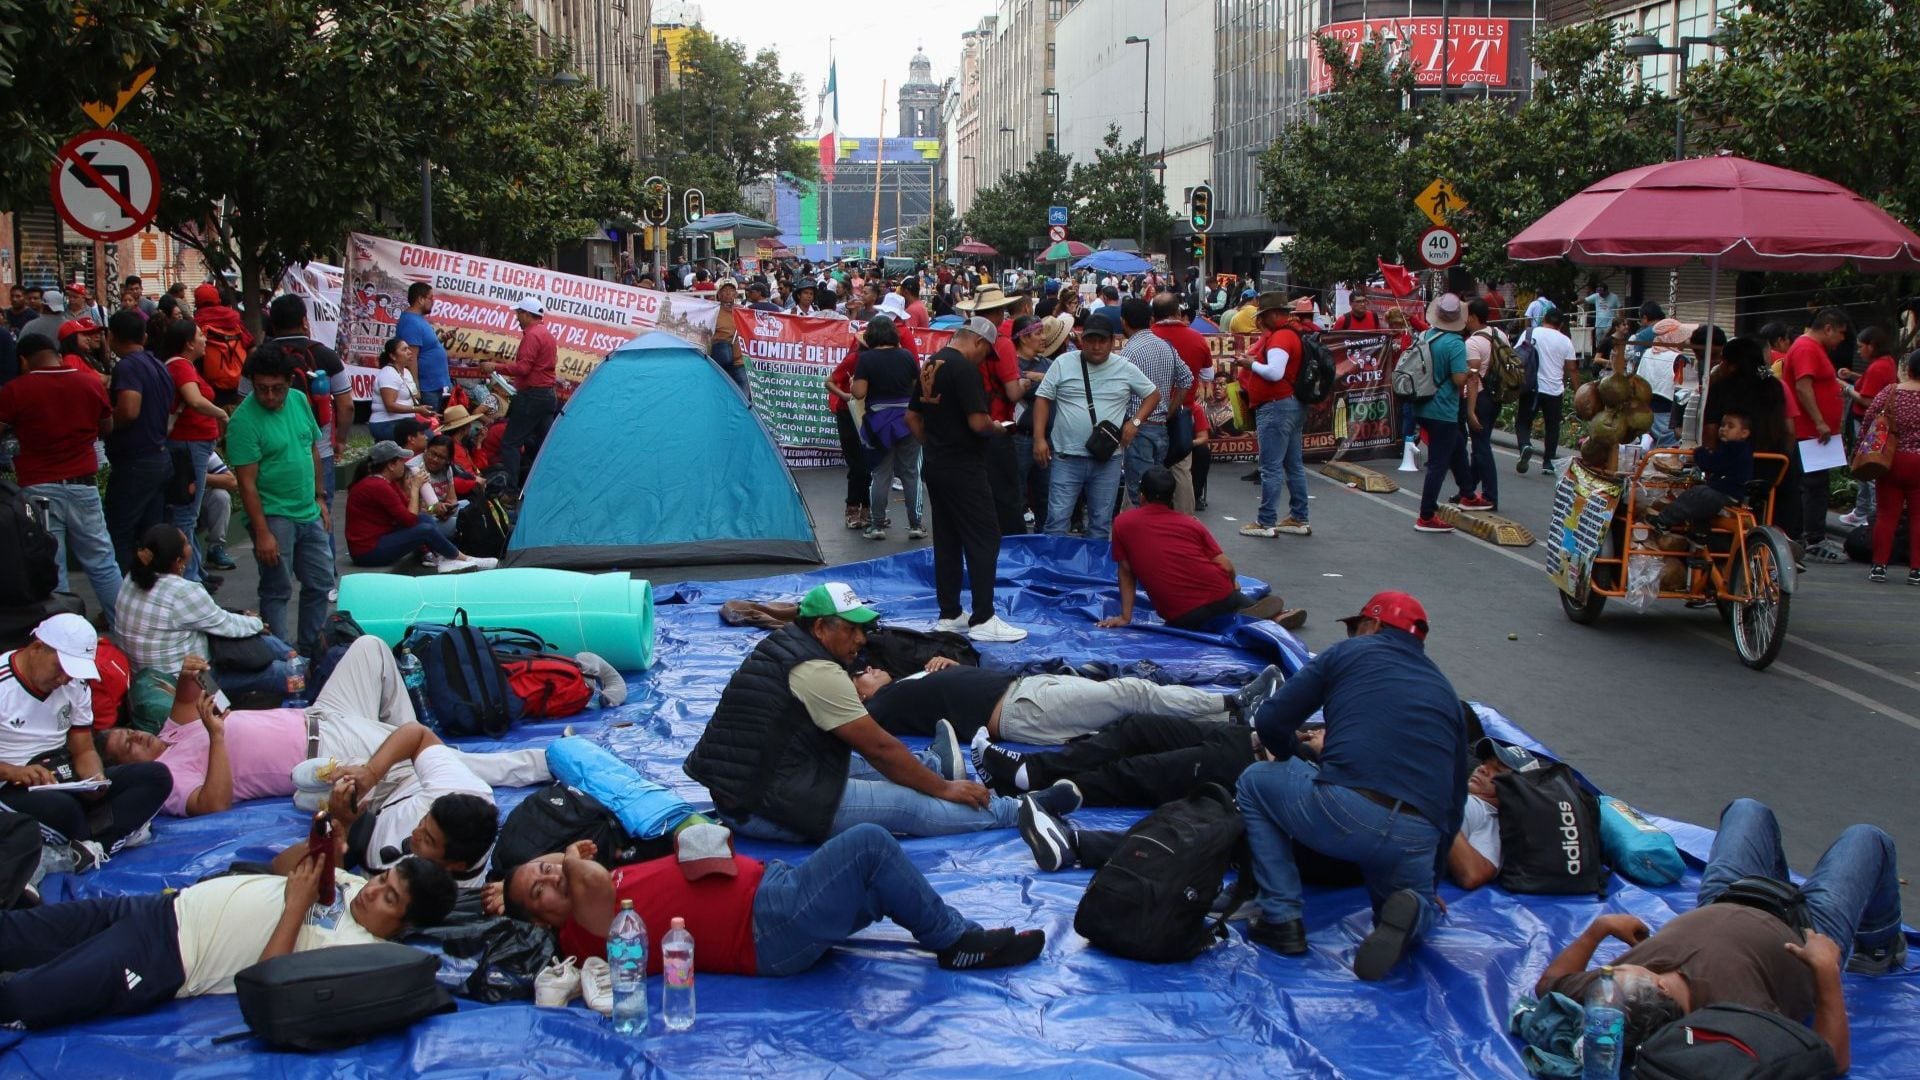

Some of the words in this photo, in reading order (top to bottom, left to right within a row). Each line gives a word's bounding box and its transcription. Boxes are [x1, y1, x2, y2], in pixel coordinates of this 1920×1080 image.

[1451, 73, 1458, 81] Y
[1460, 73, 1501, 82] COCTEL
[1429, 236, 1449, 249] 40
[1429, 251, 1449, 259] km/h
[400, 246, 463, 274] COMITÉ
[467, 260, 489, 279] DE
[493, 265, 545, 291] LUCHA
[551, 277, 657, 314] CUAUHTEPEC
[436, 276, 485, 296] ESCUELA
[545, 297, 627, 325] QUETZALCOATL
[428, 300, 509, 328] BROGACIÓN
[566, 326, 588, 346] DEL
[749, 339, 803, 360] COMITÉ
[806, 345, 825, 363] DE
[1210, 337, 1235, 356] DE
[474, 338, 493, 354] DE
[560, 357, 597, 377] SALA
[794, 379, 800, 387] A
[803, 380, 814, 388] LA
[1346, 370, 1383, 384] CNTE
[777, 412, 819, 422] SALARIAL
[1348, 401, 1388, 422] 1989
[1210, 441, 1254, 453] ZADOS
[1304, 435, 1335, 447] EMOS
[1559, 801, 1580, 875] adidas
